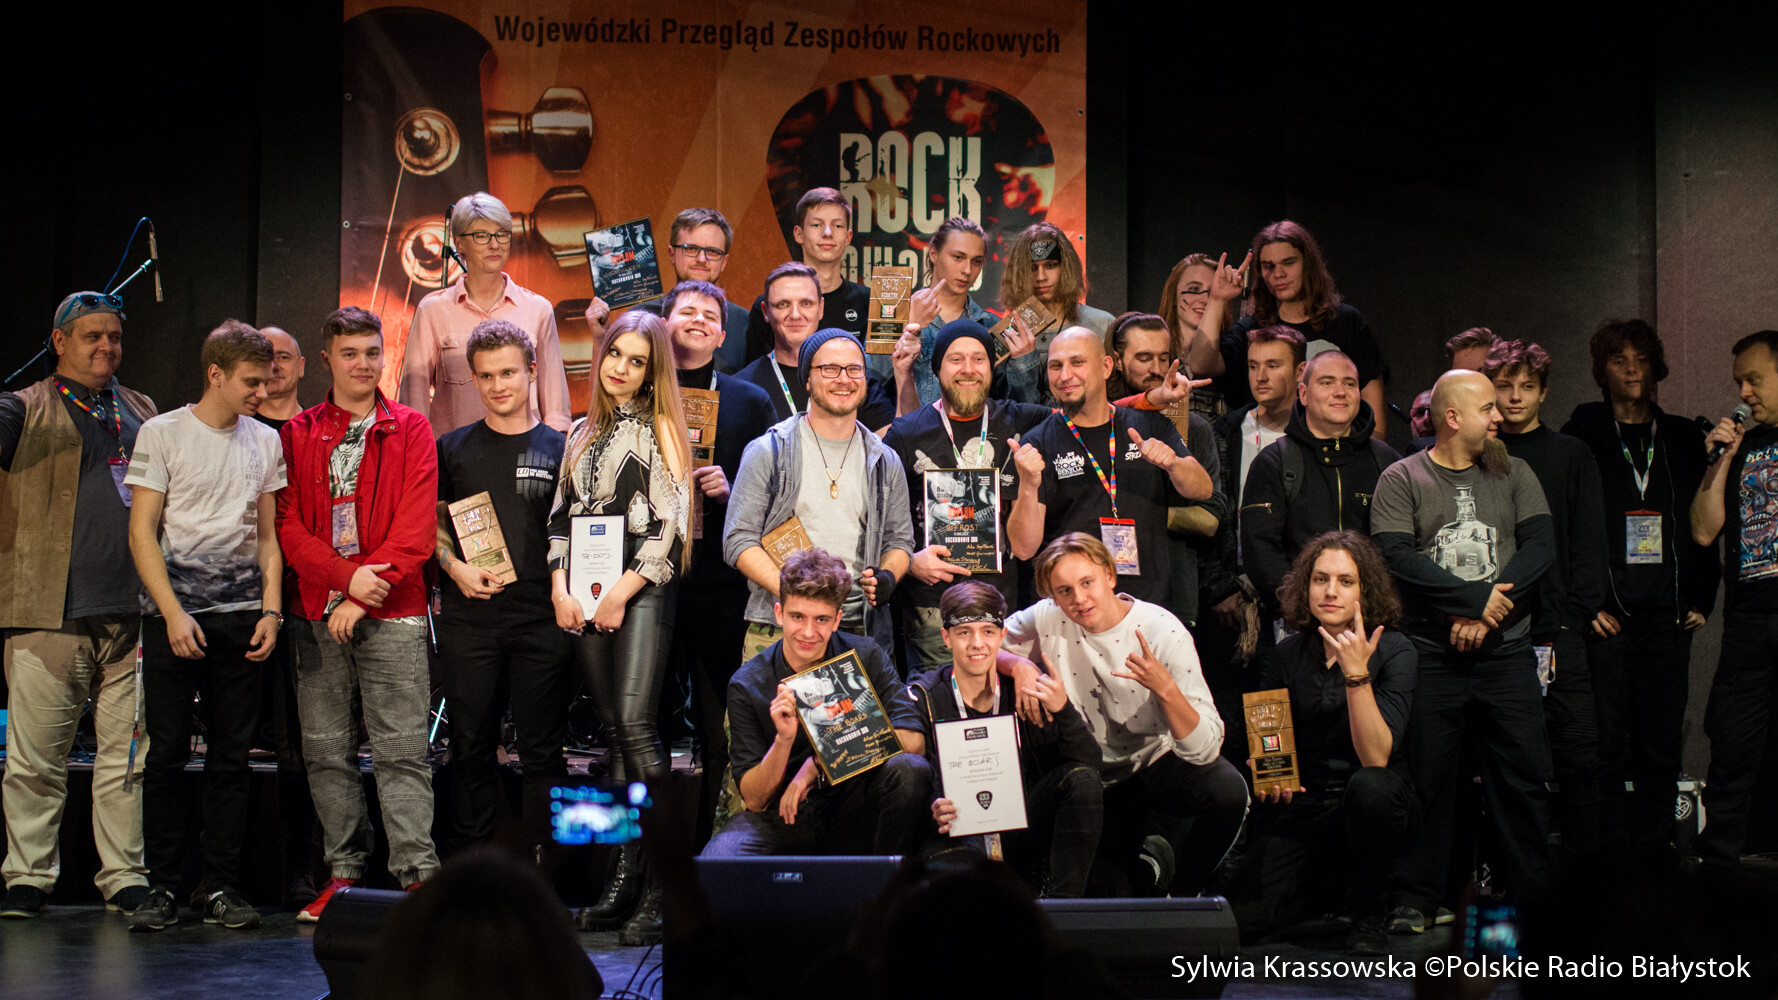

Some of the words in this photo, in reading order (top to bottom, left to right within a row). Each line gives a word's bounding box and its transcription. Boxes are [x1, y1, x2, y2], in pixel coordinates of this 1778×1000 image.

[494, 15, 651, 48] Wojewódzki
[660, 18, 775, 52] Przegląd
[784, 21, 907, 53] Zespołów
[917, 25, 1060, 58] Rockowych
[840, 130, 982, 234] ROCK
[1056, 459, 1082, 470] ROCK
